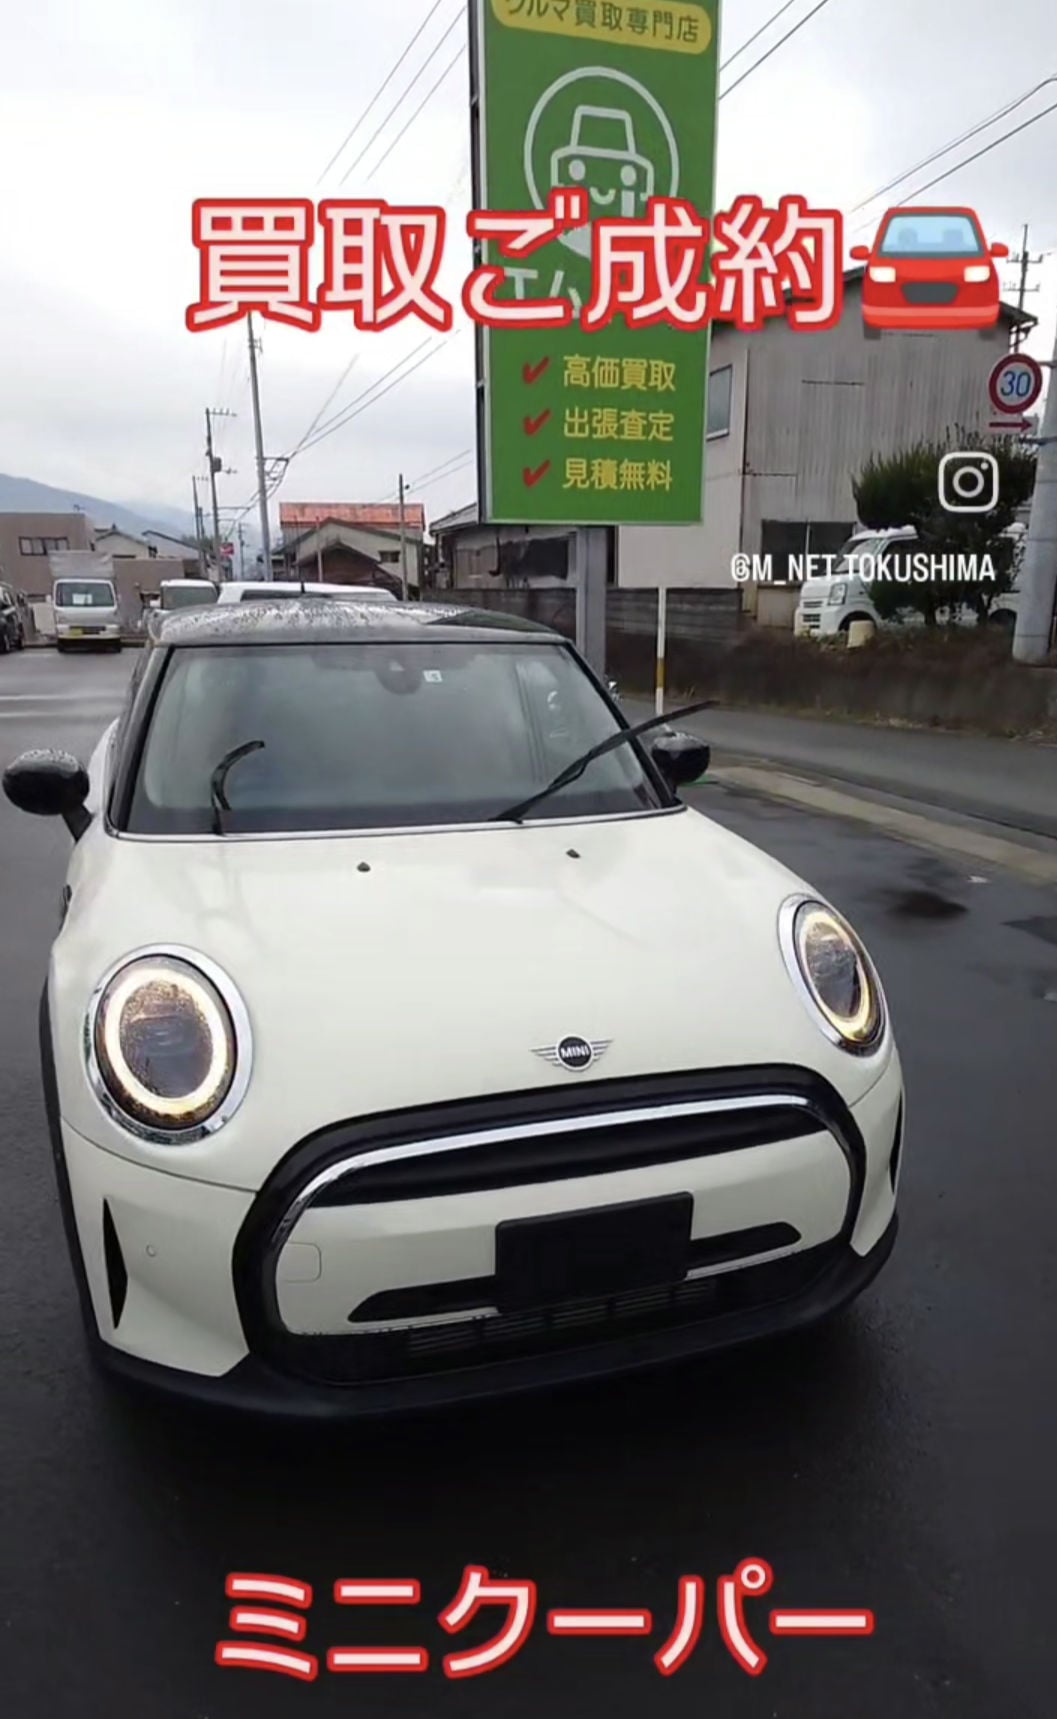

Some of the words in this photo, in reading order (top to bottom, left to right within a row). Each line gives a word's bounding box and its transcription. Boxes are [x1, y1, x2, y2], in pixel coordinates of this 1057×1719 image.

[563, 354, 676, 391] 高価買取
[1001, 371, 1031, 397] 30
[564, 407, 674, 441] 出張査定
[562, 457, 672, 491] 見積無料
[560, 1045, 590, 1058] MINI
